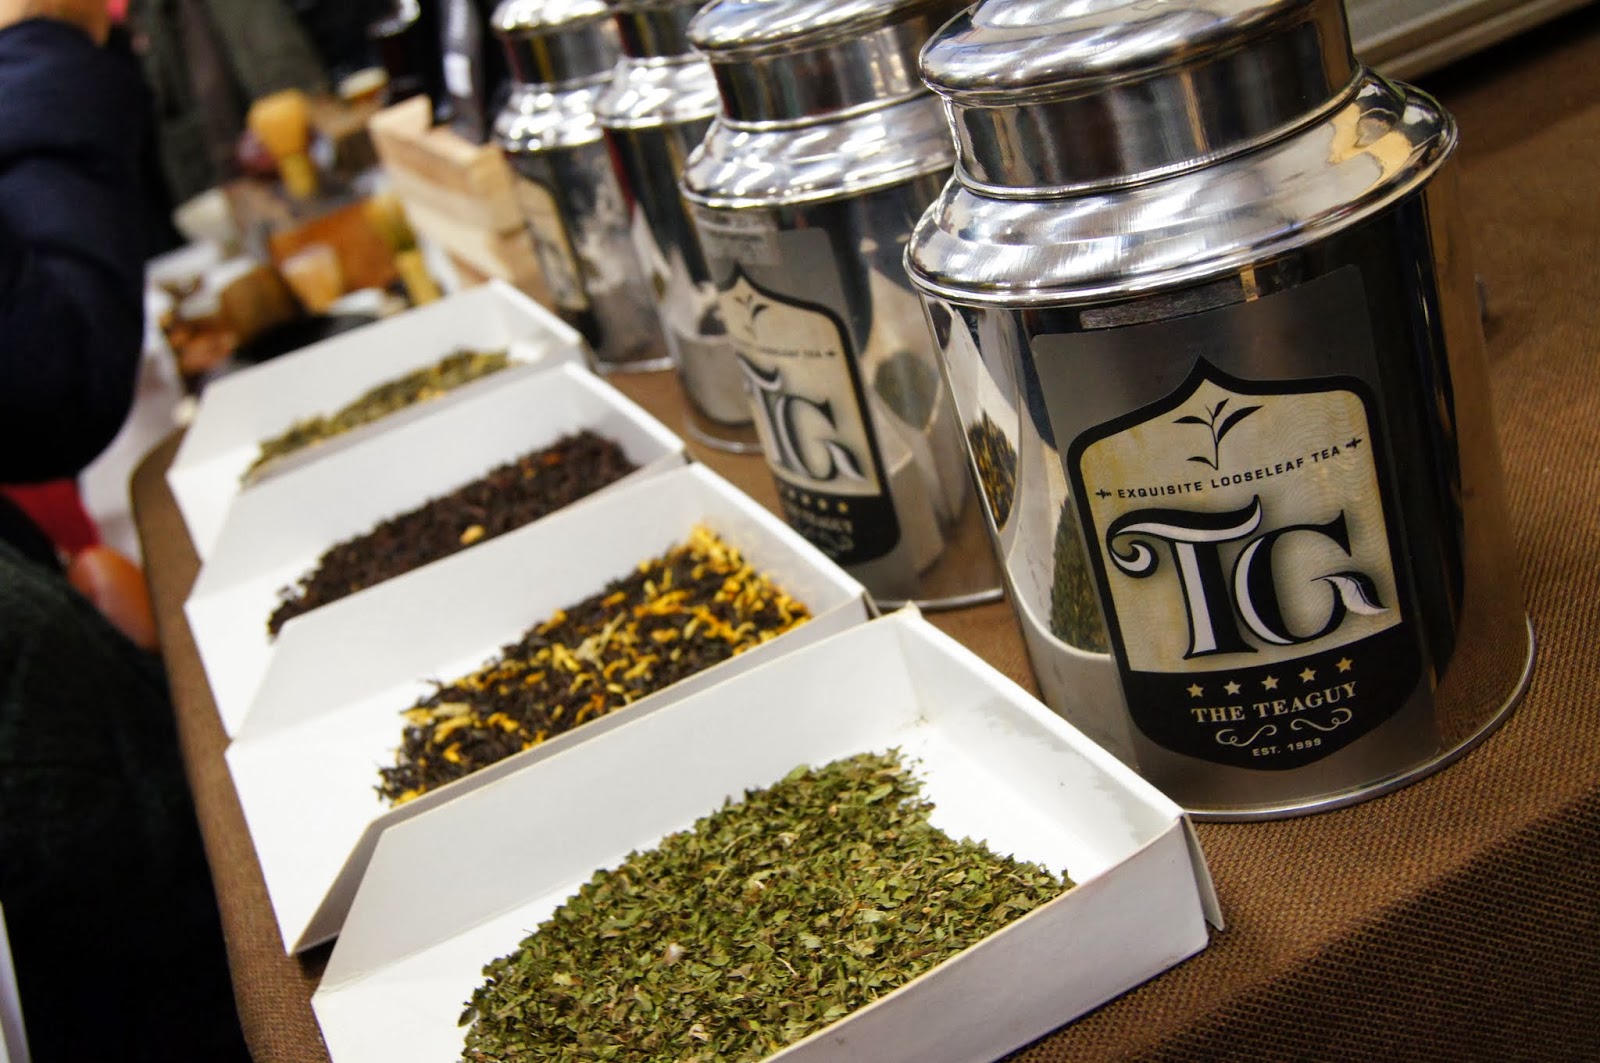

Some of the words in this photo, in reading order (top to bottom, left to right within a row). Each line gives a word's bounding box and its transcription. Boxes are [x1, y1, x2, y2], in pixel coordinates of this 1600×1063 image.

[1117, 481, 1203, 498] EXQUISITE
[1211, 458, 1304, 489] LOOSELEAF
[1311, 446, 1341, 463] TEA
[1107, 495, 1389, 660] TG
[1191, 706, 1246, 723] THE
[1253, 681, 1357, 718] TEAGUY
[1253, 746, 1281, 757] EST.
[1287, 738, 1321, 752] 1999
